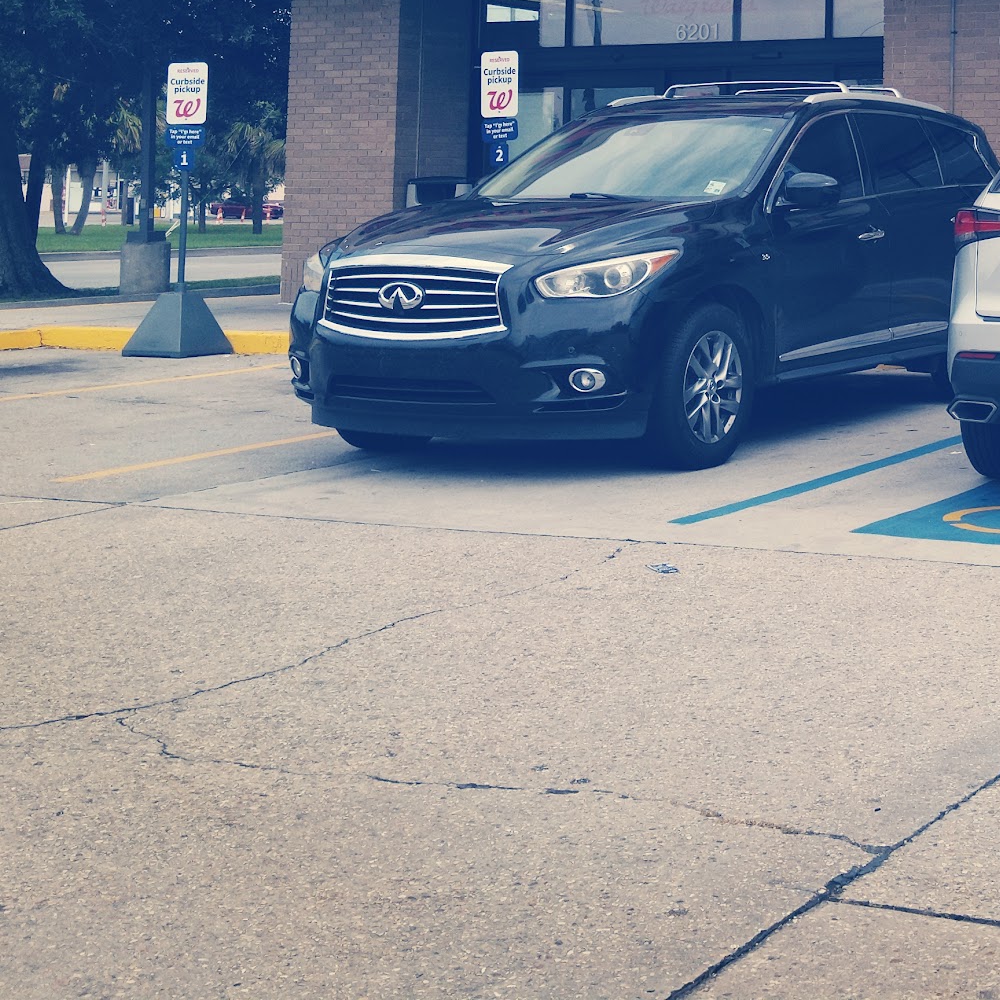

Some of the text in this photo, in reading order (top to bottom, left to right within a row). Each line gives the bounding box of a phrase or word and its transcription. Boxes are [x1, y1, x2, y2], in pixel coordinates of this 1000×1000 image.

[676, 23, 720, 41] 6201
[483, 67, 516, 76] Curbside
[170, 78, 205, 86] Curbside
[487, 75, 513, 85] pickup
[174, 85, 201, 94] pickup
[180, 153, 188, 165] 1
[495, 150, 503, 162] 2
